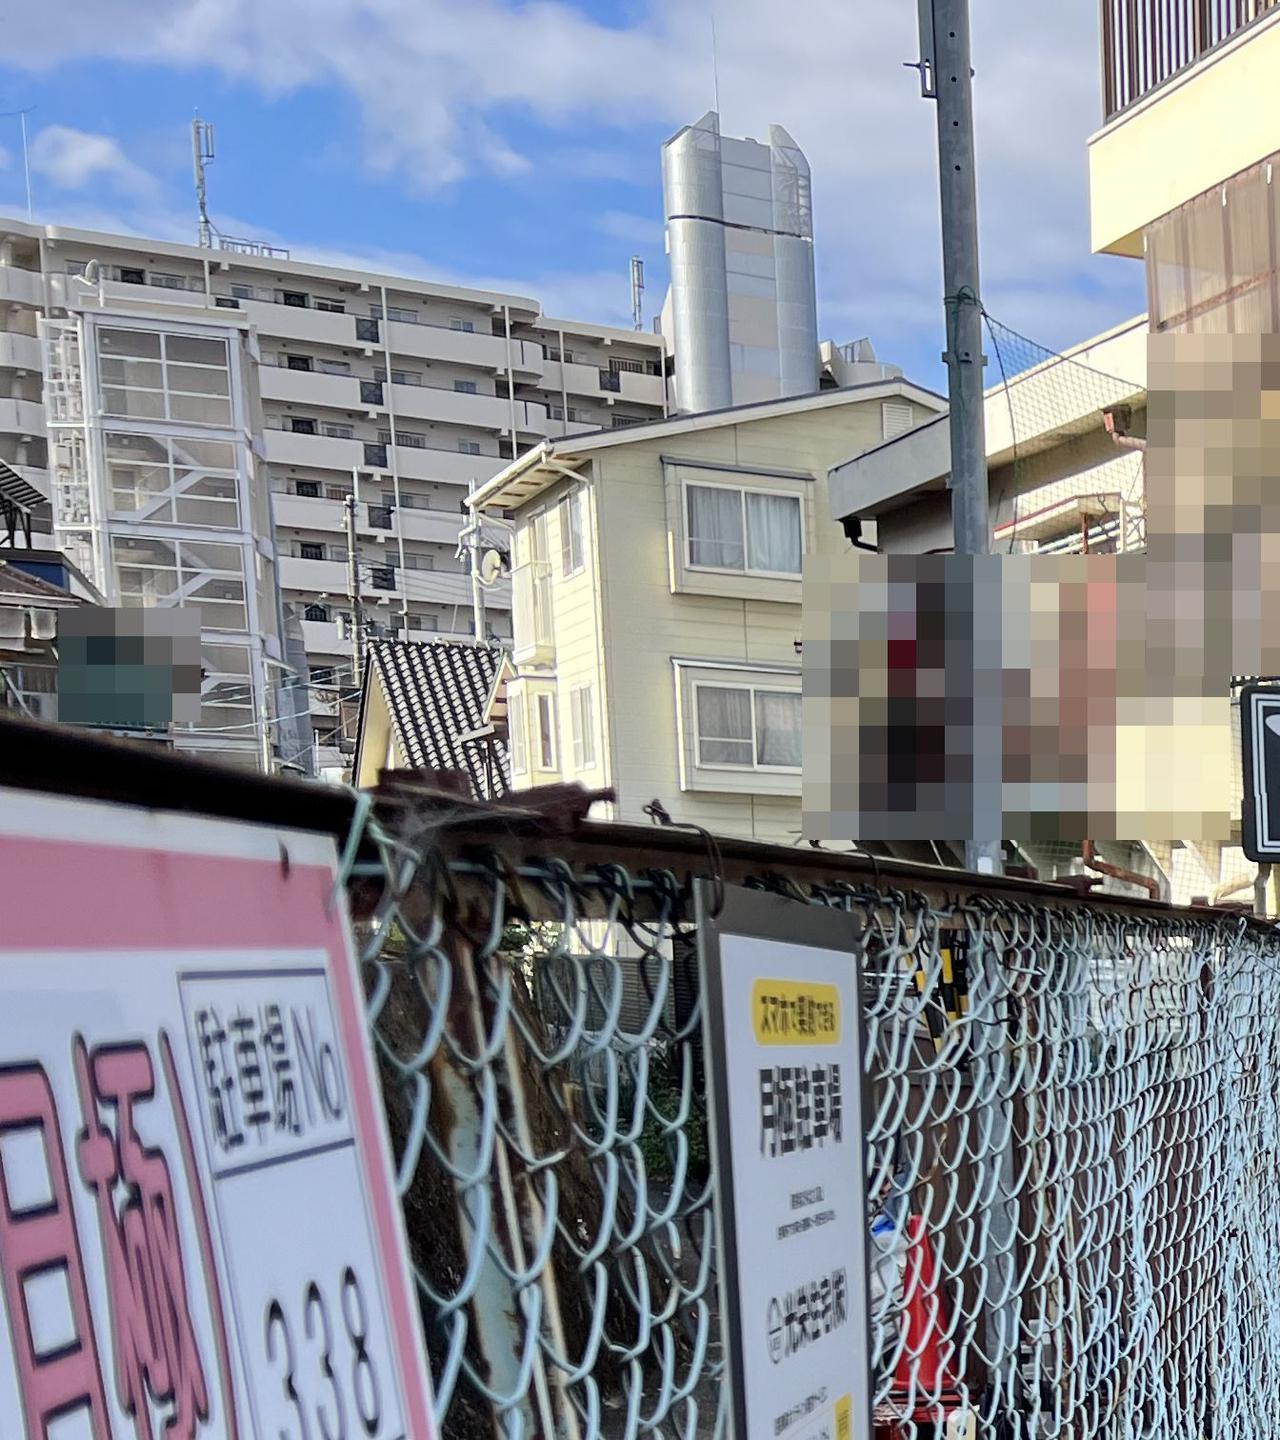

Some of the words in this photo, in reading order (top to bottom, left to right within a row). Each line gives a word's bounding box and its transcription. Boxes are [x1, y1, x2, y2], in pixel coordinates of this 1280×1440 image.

[195, 1003, 343, 1149] 駐車場No
[758, 1063, 842, 1157] 月極駐車場
